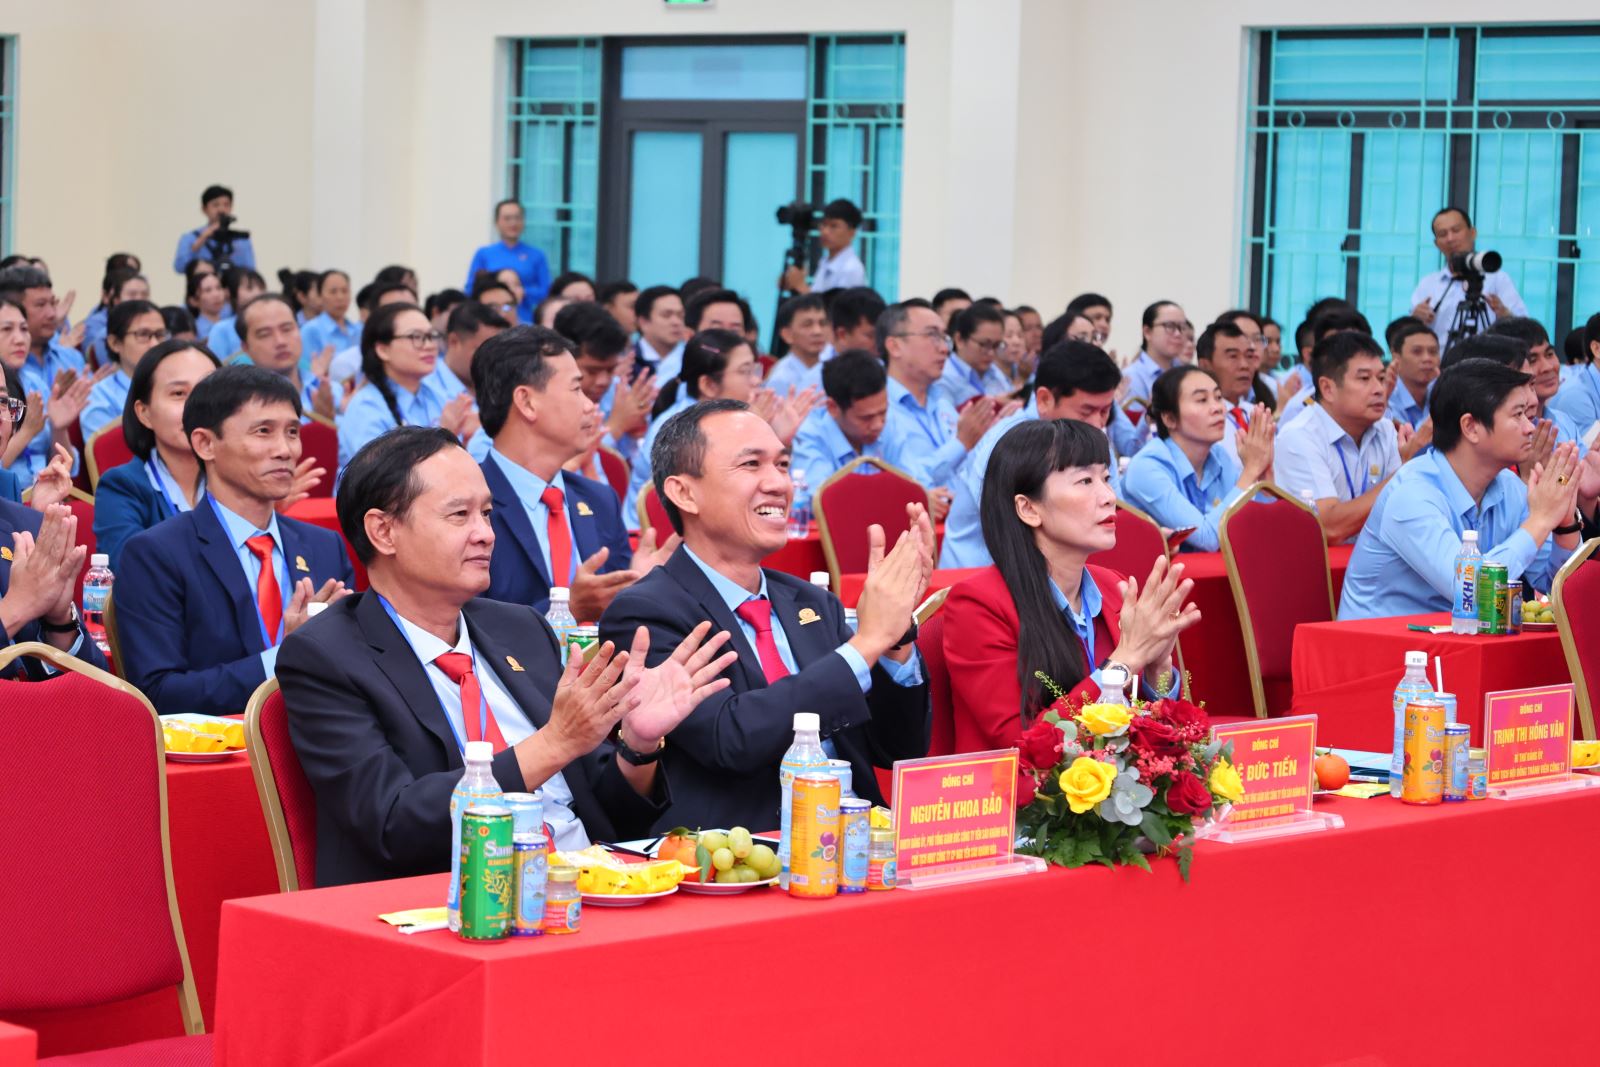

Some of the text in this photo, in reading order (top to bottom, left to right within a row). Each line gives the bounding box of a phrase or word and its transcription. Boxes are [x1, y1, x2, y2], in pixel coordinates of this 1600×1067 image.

[1493, 728, 1515, 747] TRỊNH
[1516, 727, 1528, 745] THỊ
[1529, 720, 1548, 740] HỒNG
[962, 772, 974, 785] CHÍ
[1247, 761, 1270, 782] ĐỨC
[1273, 755, 1297, 778] TIẾN
[910, 792, 1002, 824] NGUYỄN KHOA BẢO
